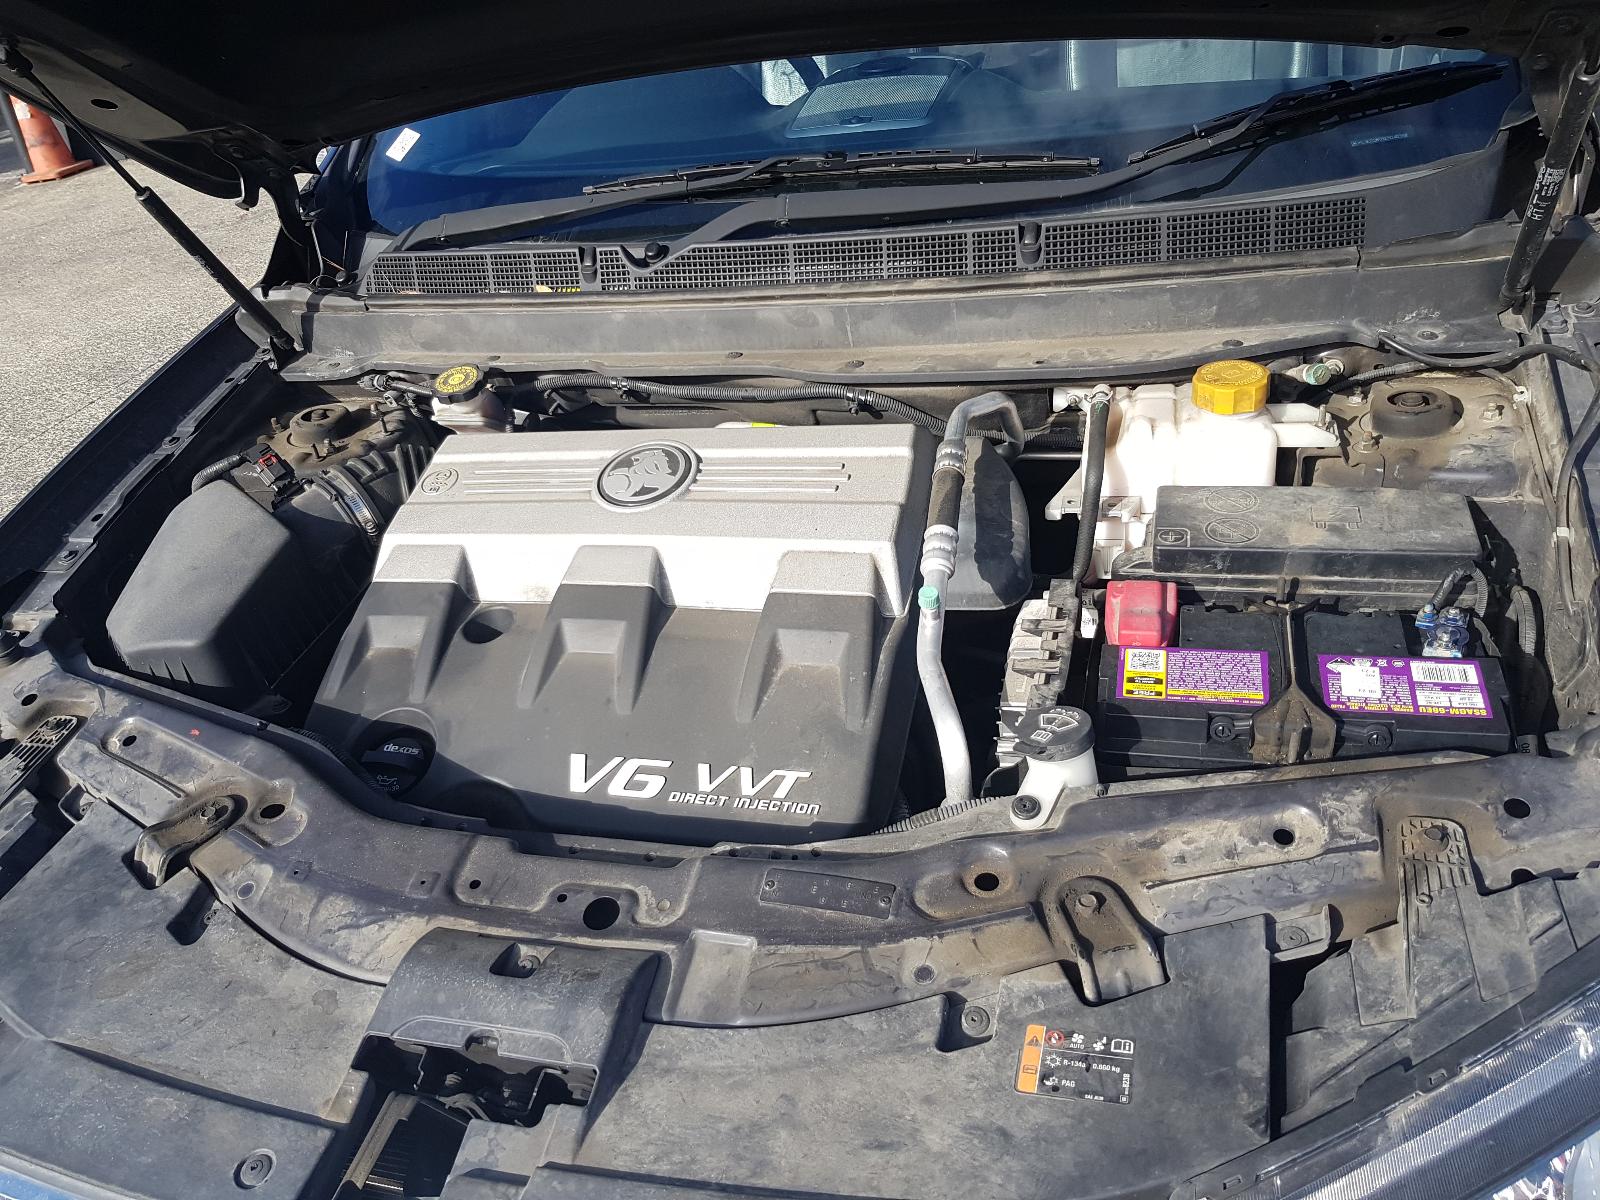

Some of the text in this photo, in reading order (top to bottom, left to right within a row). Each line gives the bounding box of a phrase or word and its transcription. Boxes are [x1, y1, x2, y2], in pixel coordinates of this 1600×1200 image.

[383, 743, 422, 755] dexos
[570, 753, 813, 799] V6 VVT
[668, 791, 821, 815] DIRECT INJECTION
[1063, 1060, 1086, 1068] R-134a
[1111, 1065, 1121, 1074] kg
[1061, 1079, 1076, 1088] PAG
